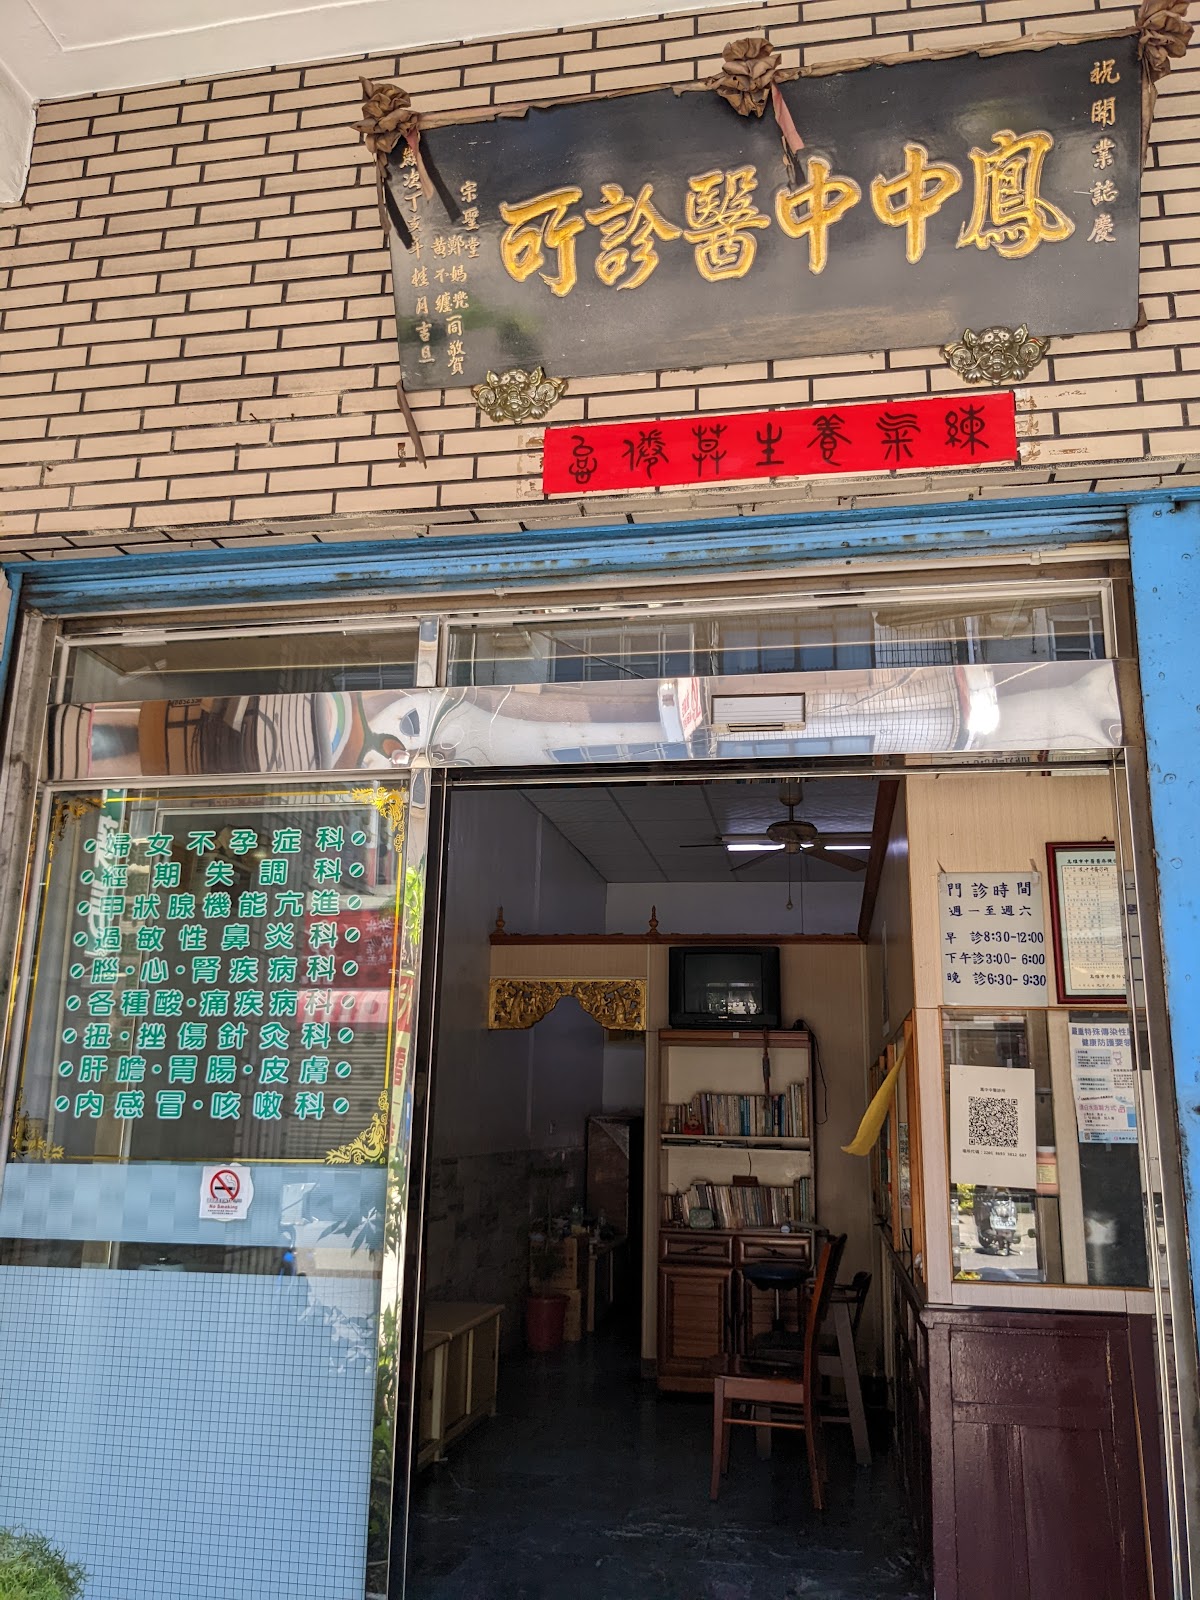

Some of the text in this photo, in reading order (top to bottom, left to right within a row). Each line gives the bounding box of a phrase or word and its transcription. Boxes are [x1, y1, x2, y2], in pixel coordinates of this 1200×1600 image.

[1087, 58, 1121, 243] 祝開業誌慶
[500, 129, 1075, 297] 鳳中中醫診所
[106, 825, 344, 857] 婦女不孕症科
[102, 858, 342, 889] 經期失調科
[98, 889, 340, 920] 甲狀腺機能亢進
[947, 882, 1032, 899] 門診時間
[948, 905, 1032, 917] 週一至週六
[94, 922, 338, 951] 過敏性鼻炎科
